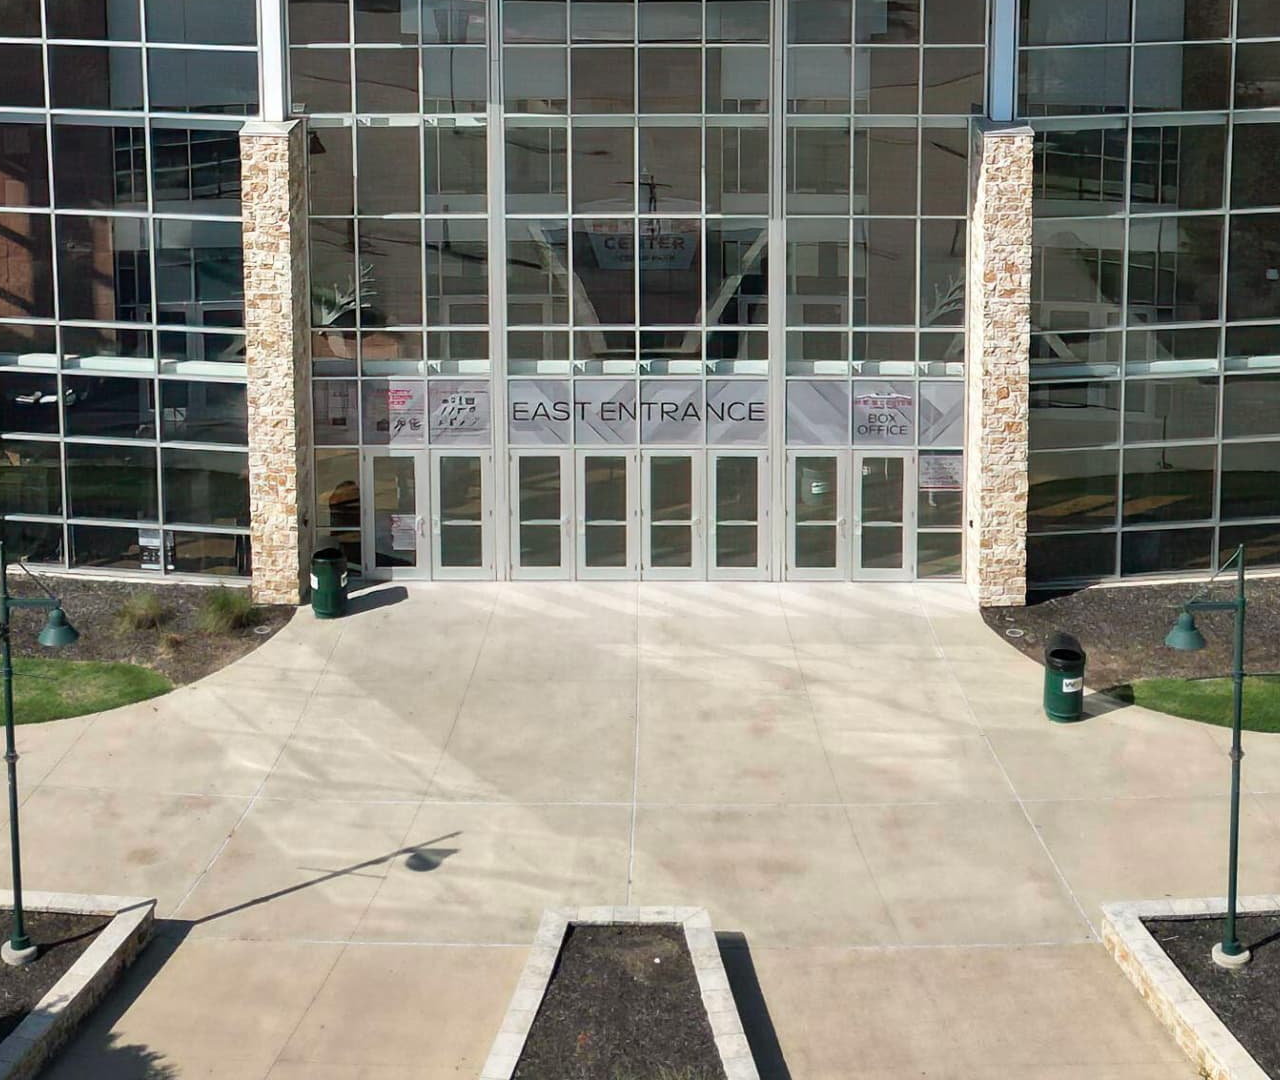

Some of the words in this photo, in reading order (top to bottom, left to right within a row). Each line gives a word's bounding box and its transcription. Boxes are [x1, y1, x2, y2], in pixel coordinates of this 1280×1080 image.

[513, 402, 592, 421] EAST
[600, 402, 765, 421] ENTRANCE
[868, 413, 896, 424] BOX
[857, 425, 908, 436] OFFICE
